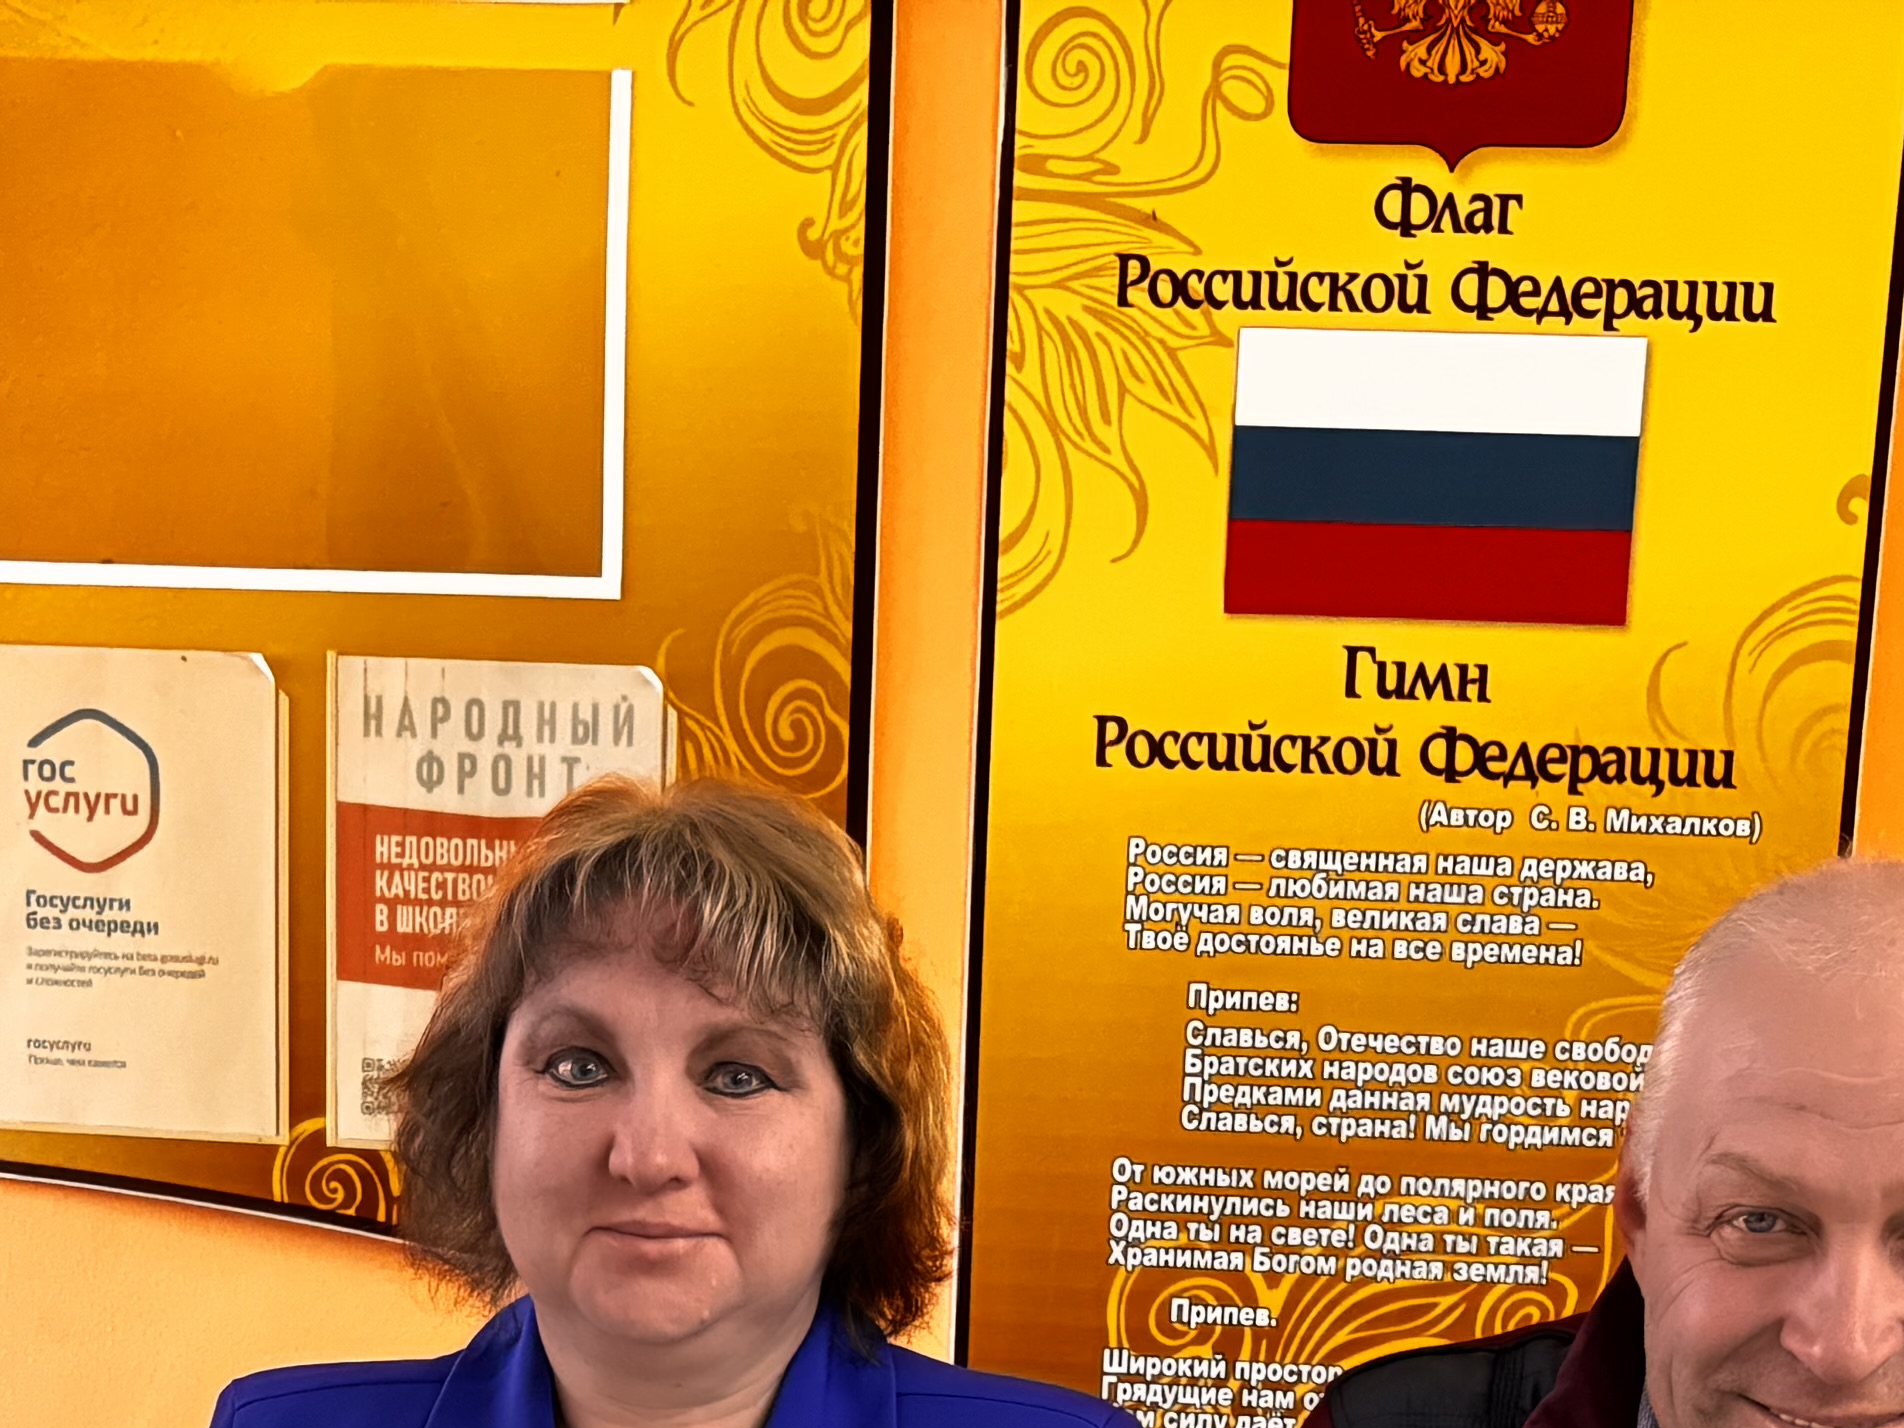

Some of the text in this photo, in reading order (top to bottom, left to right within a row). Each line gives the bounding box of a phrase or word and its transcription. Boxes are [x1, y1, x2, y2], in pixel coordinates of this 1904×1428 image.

[1373, 175, 1524, 238] Флаг
[1114, 252, 1777, 332] Российской Федерации
[1342, 644, 1492, 705] Гимн
[362, 694, 636, 748] НАРОДНЫЙ
[22, 758, 76, 784] гос
[415, 749, 582, 798] ФРОНТ
[1092, 714, 1737, 795] Российской Федерации
[23, 788, 139, 823] услуги
[1419, 799, 1763, 845] (Автор С. В. Михалков)
[1128, 836, 1228, 866] Россия
[1270, 848, 1429, 875] священная
[1436, 853, 1512, 877] наша
[1520, 857, 1655, 888] держава,
[26, 889, 131, 915] Госуслуги
[1126, 866, 1227, 895] Россия
[1268, 873, 1400, 902] любимая
[1408, 881, 1484, 906] наша
[1493, 885, 1600, 912] страна.
[26, 911, 160, 938] без очереди
[375, 903, 463, 935] В ШКОЛ
[1125, 895, 1241, 927] Могучая
[1249, 904, 1324, 933] воля,
[1331, 906, 1448, 934] великая
[1456, 912, 1541, 936] слава
[375, 944, 406, 967] Мы
[1124, 922, 1584, 969] Твоё достоянье на все времена!
[1188, 982, 1299, 1016] Припев:
[1186, 1020, 1309, 1056] Славься,
[1317, 1025, 1461, 1057] Отечество
[1471, 1037, 1546, 1059] наше
[1184, 1048, 1645, 1093] Братских народов союз вековой
[1183, 1076, 1323, 1110] Предками
[1329, 1088, 1431, 1113] данная
[1440, 1092, 1571, 1120] мудрость
[1181, 1104, 1614, 1149] Славься, страна! Мы гордимся
[1112, 1156, 1616, 1208] От южных морей до полярного края
[1110, 1184, 1559, 1230] Раскинулись наши леса и поля.
[1109, 1212, 1179, 1243] Одна
[1186, 1221, 1220, 1242] ты
[1229, 1223, 1263, 1245] на
[1271, 1223, 1355, 1249] свете!
[1364, 1223, 1435, 1254] Одна
[1443, 1233, 1477, 1255] ты
[1486, 1234, 1564, 1258] такая
[1108, 1239, 1549, 1286] Хранимая Богом родная земля!
[1170, 1297, 1277, 1330] Припев.
[1103, 1348, 1227, 1381] Широкий
[1101, 1374, 1234, 1409] Грядущие
[1241, 1388, 1295, 1410] нам
